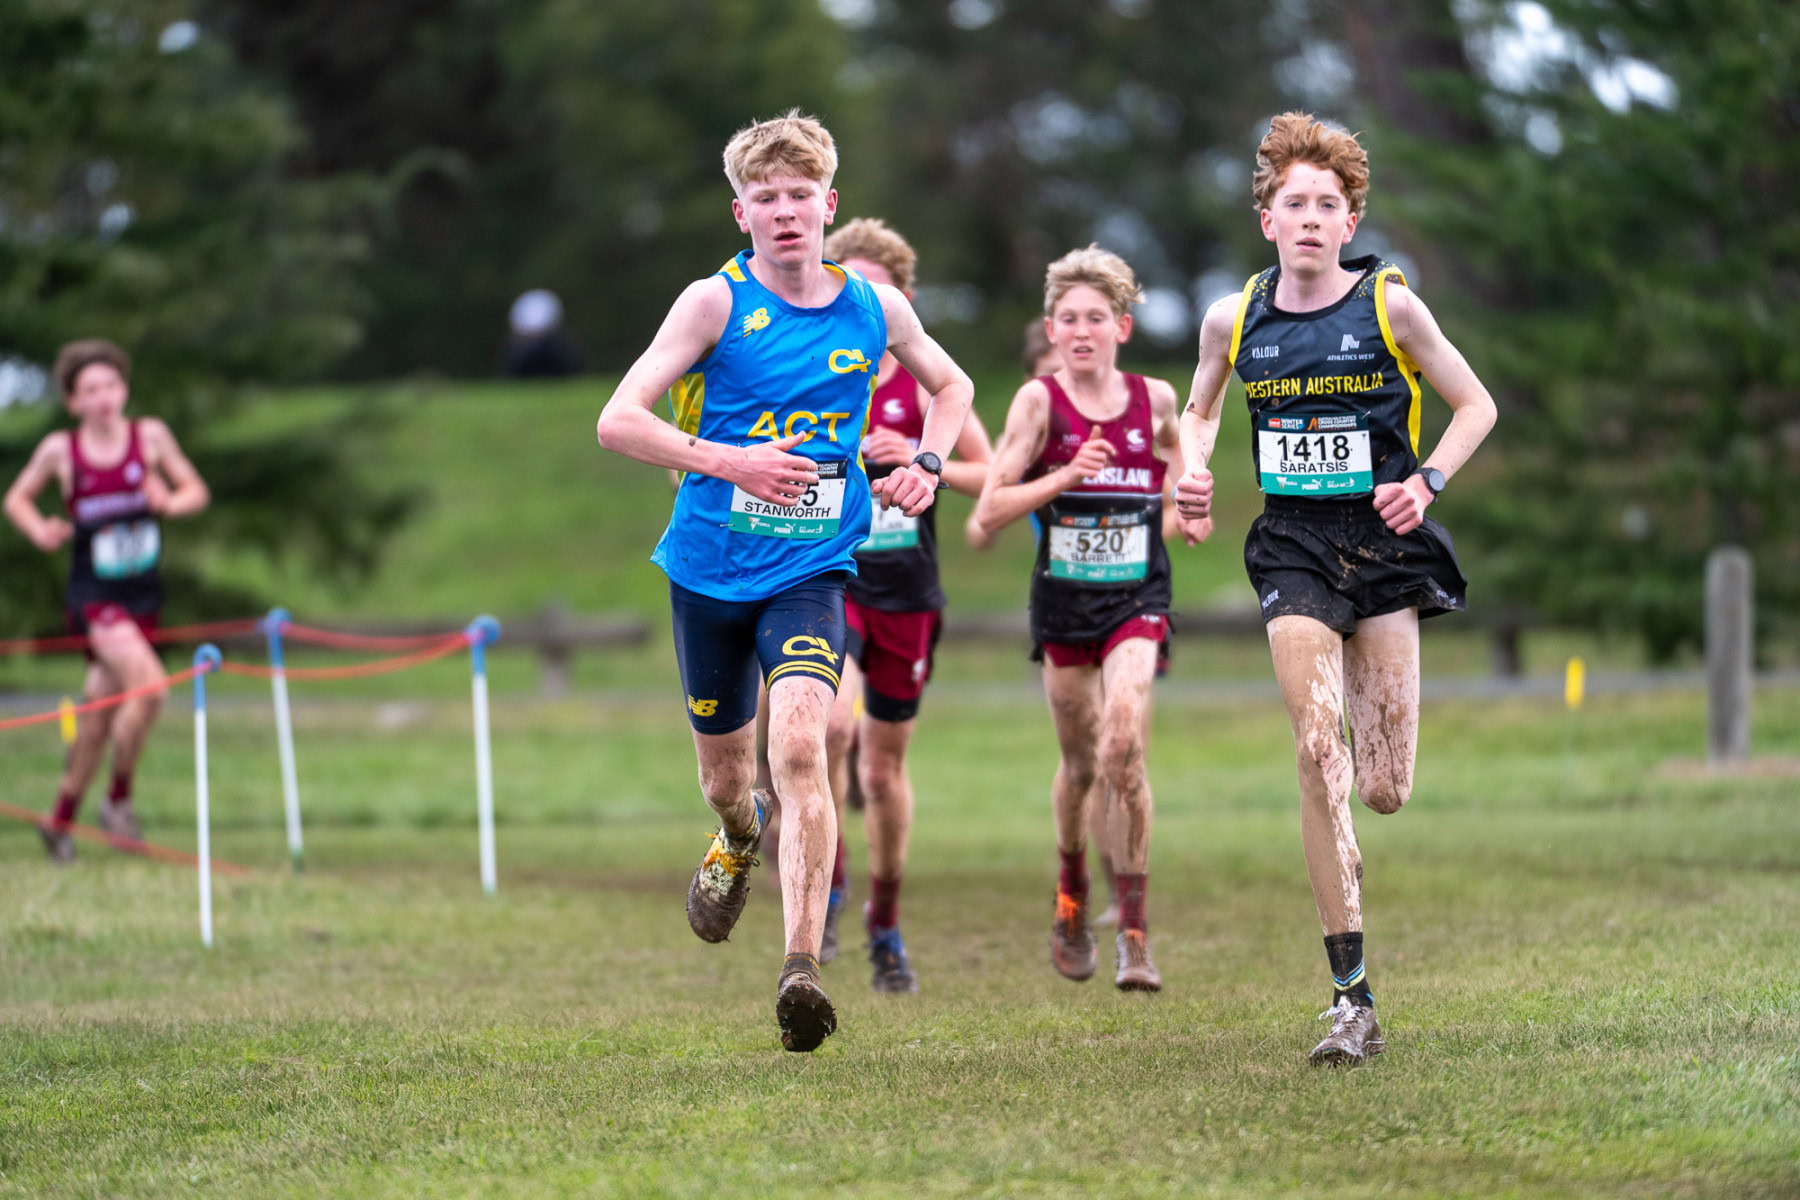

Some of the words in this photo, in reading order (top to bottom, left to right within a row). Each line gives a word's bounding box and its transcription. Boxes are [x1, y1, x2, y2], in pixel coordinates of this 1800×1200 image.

[1251, 345, 1280, 359] VALOUR
[1327, 354, 1358, 362] ATHLETICS
[1305, 371, 1384, 395] AUSTRALIA
[747, 410, 850, 443] ACT
[1277, 434, 1350, 462] 1418
[1280, 461, 1349, 473] SARATSIS
[744, 501, 832, 518] STANWORTH
[1076, 530, 1124, 553] 520
